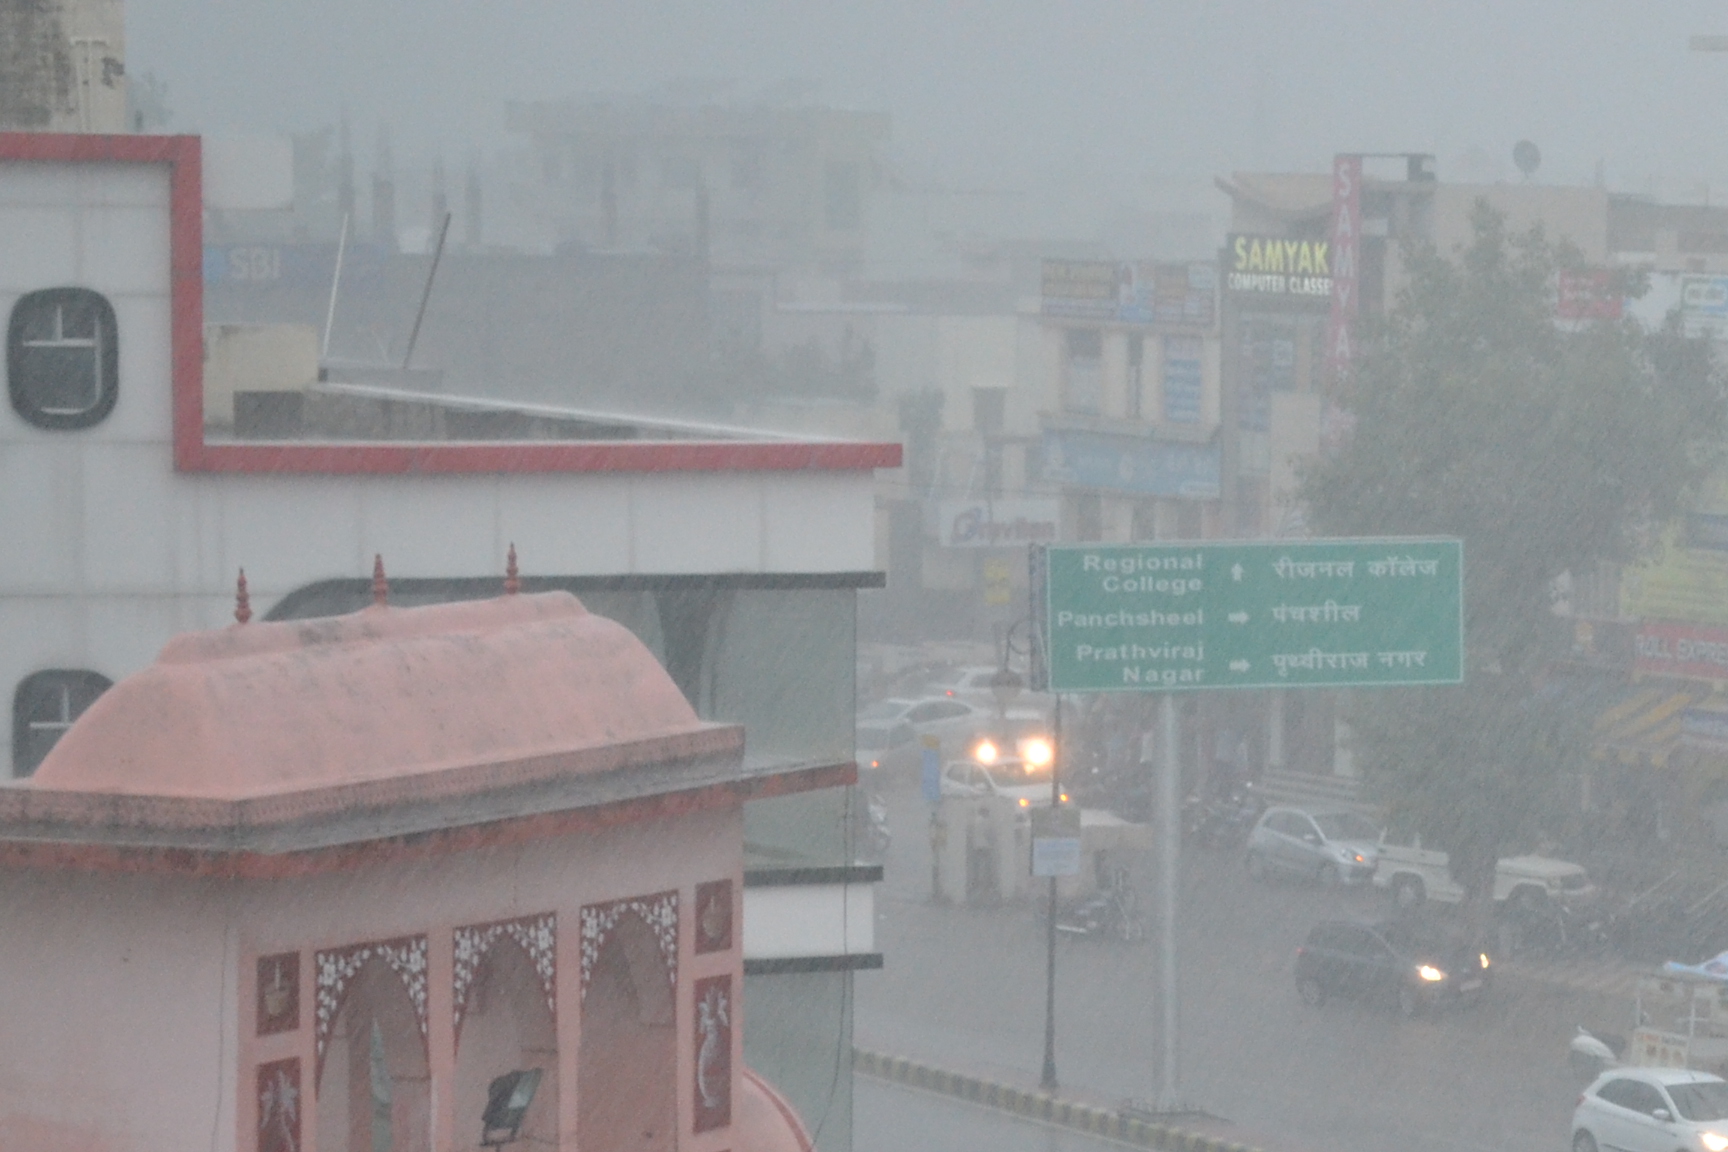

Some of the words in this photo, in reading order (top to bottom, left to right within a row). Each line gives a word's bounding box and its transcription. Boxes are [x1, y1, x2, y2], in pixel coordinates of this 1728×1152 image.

[229, 246, 282, 280] SBI
[1235, 236, 1328, 275] SAMYAK
[1228, 271, 1286, 292] COMPUTER
[1083, 553, 1203, 575] Regional
[1272, 555, 1355, 579] रीजनल
[1367, 555, 1439, 578] कॉलेज
[1102, 576, 1203, 596] College
[1058, 607, 1204, 627] Panchsheel
[1272, 598, 1362, 623] पंचशील
[1076, 641, 1204, 662] Prathviraj
[1271, 646, 1370, 678] पृथ्वीराज
[1377, 650, 1427, 668] नगर
[1123, 665, 1204, 686] Nagar
